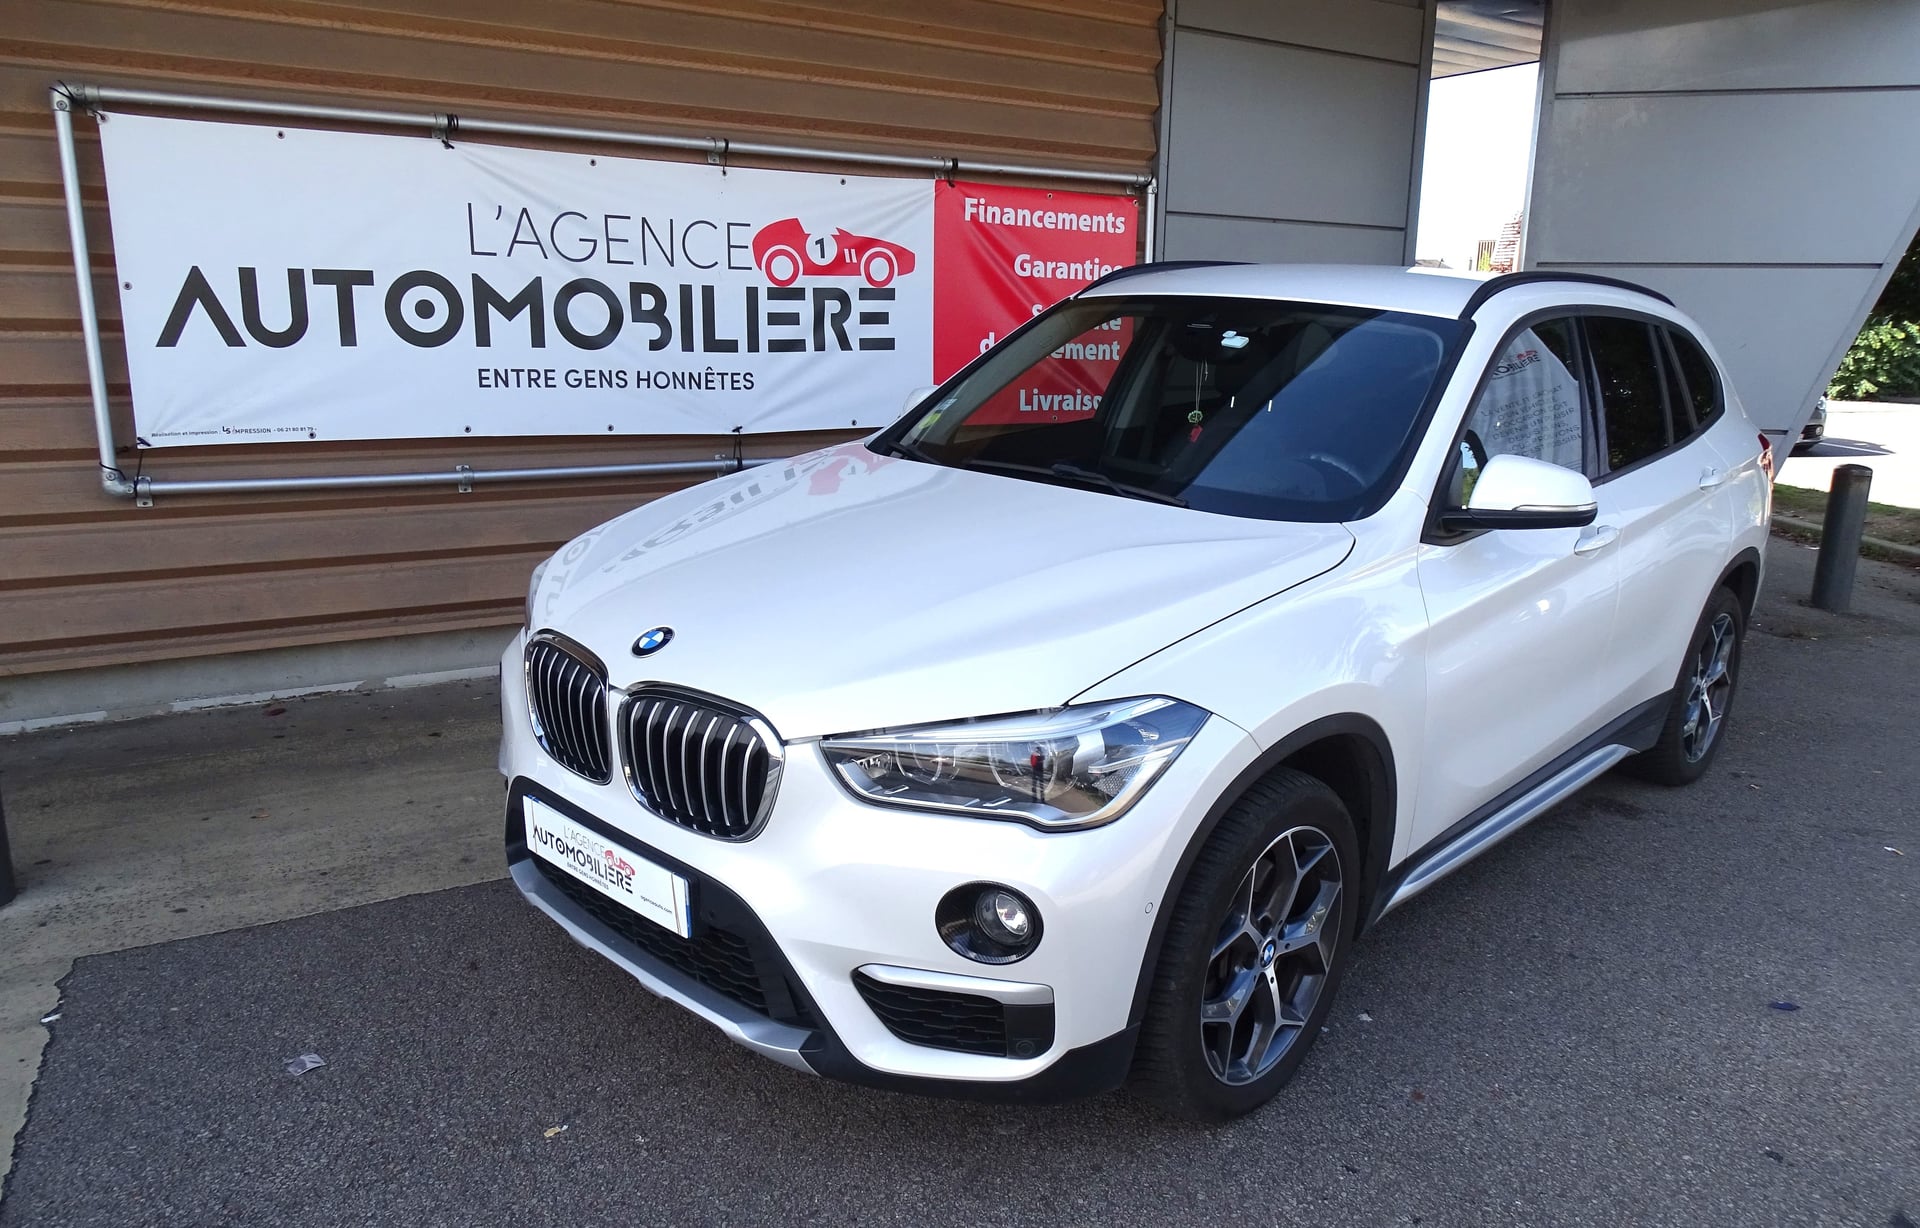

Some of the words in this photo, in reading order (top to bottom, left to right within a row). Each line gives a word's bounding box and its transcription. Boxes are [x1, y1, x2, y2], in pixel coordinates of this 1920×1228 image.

[964, 197, 1126, 234] Financements
[467, 202, 753, 271] L'AGENCE
[814, 237, 826, 259] 1
[155, 265, 896, 353] AUTOMOBILIERE
[477, 368, 557, 389] ENTRE
[564, 369, 628, 389] GENS
[636, 366, 755, 391] HONNÊTES
[1019, 388, 1103, 411] Livraiso
